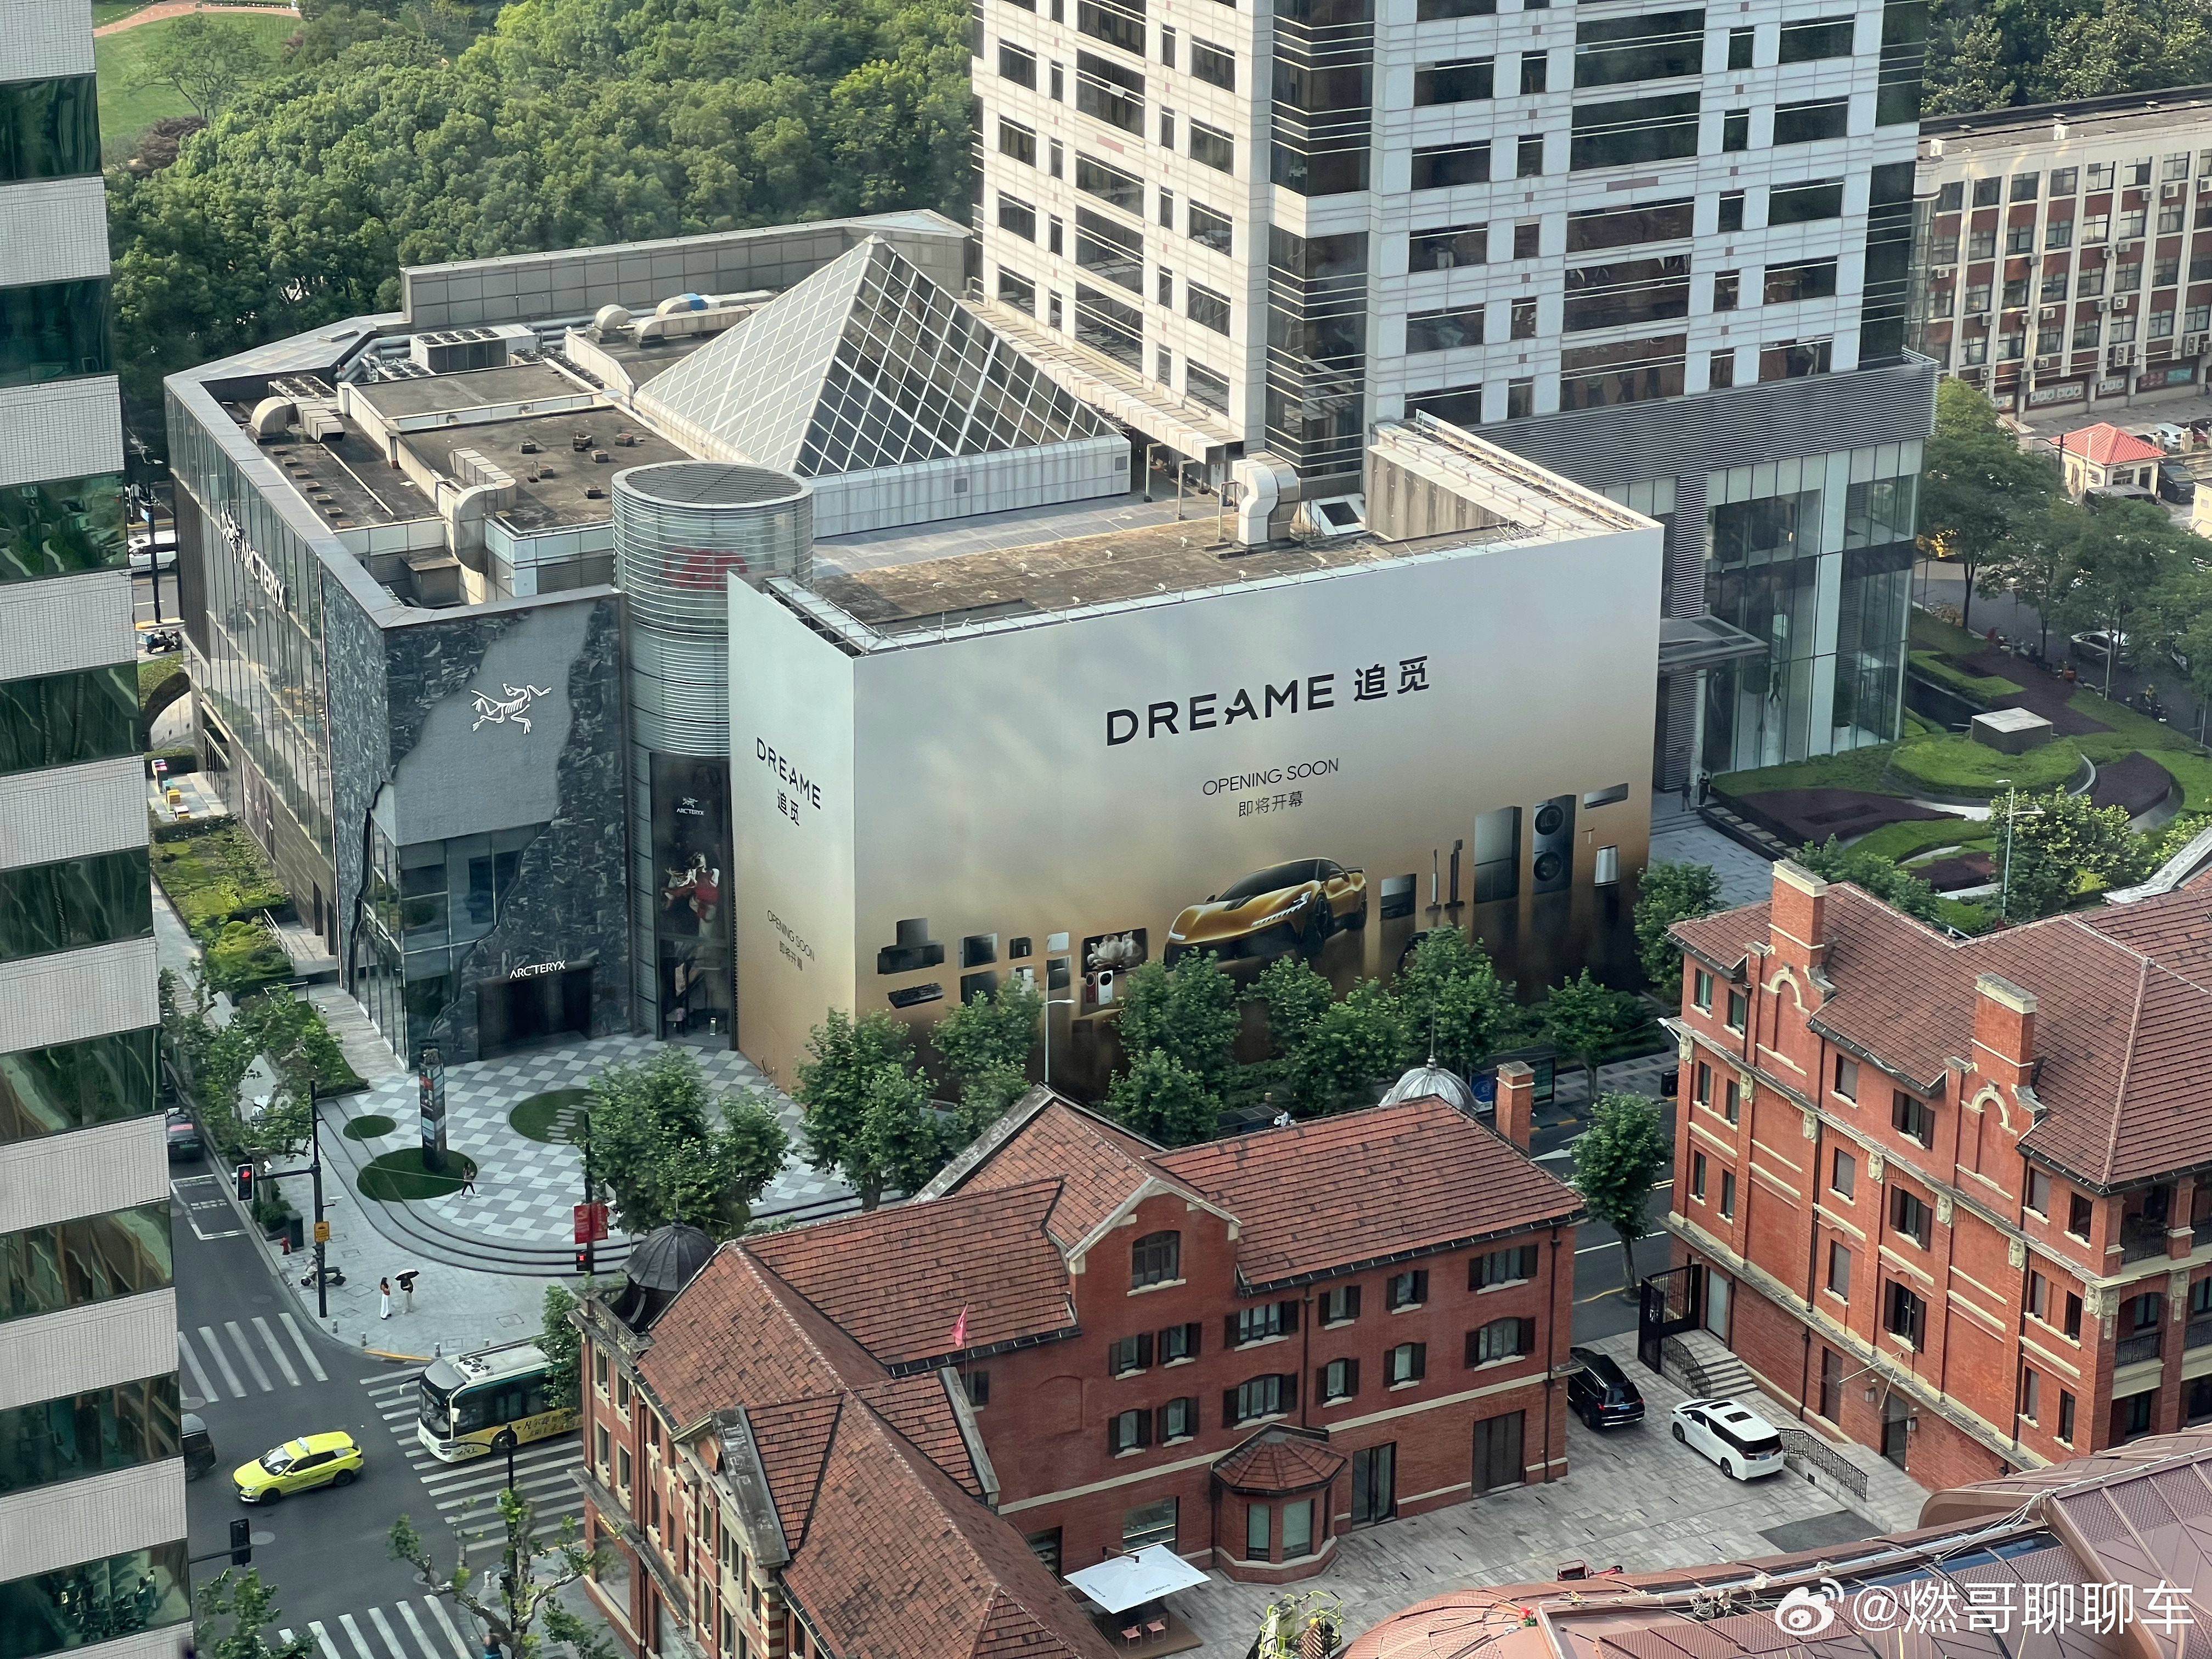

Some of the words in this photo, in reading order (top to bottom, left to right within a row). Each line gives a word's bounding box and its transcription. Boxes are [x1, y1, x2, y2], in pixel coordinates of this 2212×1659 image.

[1107, 674, 1334, 746] DREAME
[1353, 655, 1430, 702] 追觅
[757, 737, 821, 810] DREAME
[1202, 769, 1283, 795] OPENING
[1286, 758, 1339, 780] SOON
[777, 788, 800, 827] 追觅
[1239, 791, 1304, 817] 即将开幕
[767, 910, 794, 942] OPENING
[795, 935, 815, 962] SOON
